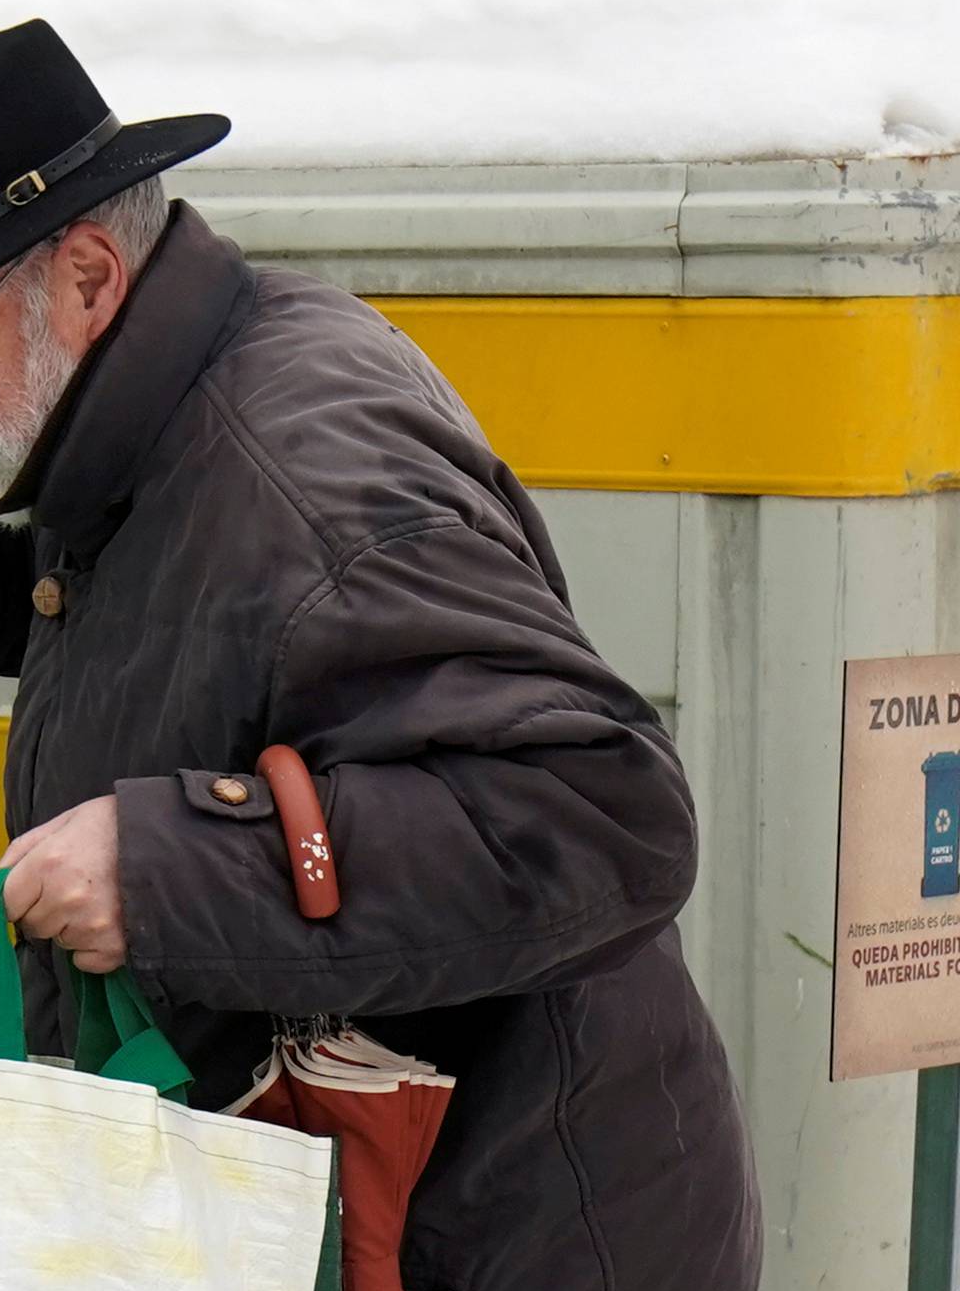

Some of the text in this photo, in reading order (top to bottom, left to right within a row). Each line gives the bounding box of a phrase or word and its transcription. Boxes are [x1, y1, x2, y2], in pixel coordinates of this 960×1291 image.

[869, 694, 940, 730] ZONA
[847, 922, 877, 939] Altres
[879, 915, 926, 933] materials
[927, 916, 939, 929] es
[852, 944, 899, 969] QUEDA
[865, 961, 940, 987] MATERIALS
